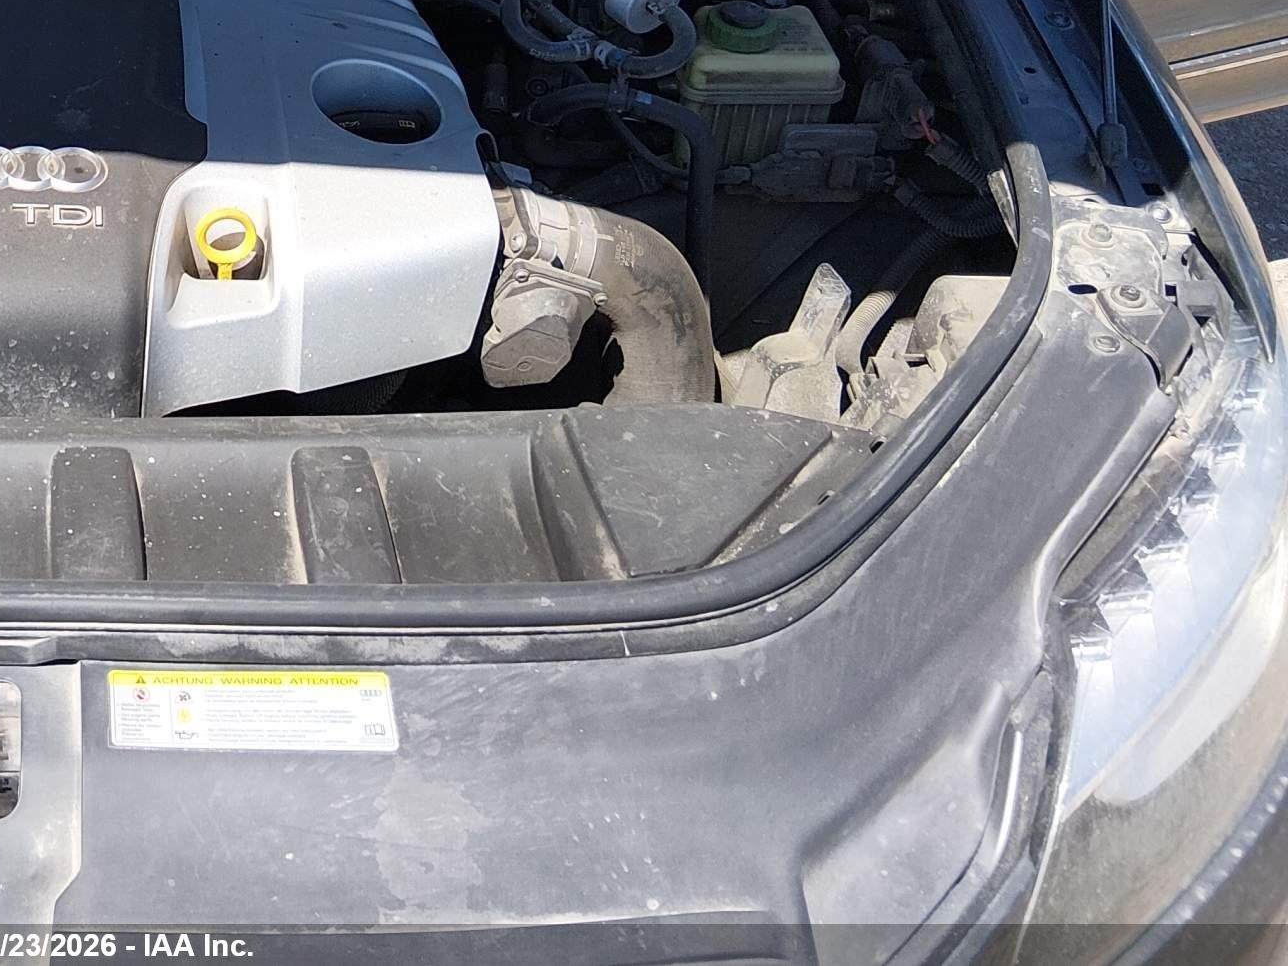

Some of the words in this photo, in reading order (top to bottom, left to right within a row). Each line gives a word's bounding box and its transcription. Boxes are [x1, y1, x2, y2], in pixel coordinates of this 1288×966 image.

[12, 203, 104, 227] TDI
[152, 676, 214, 685] ACHTUNG
[221, 676, 282, 685] WARNING
[290, 676, 359, 685] ATTENTION
